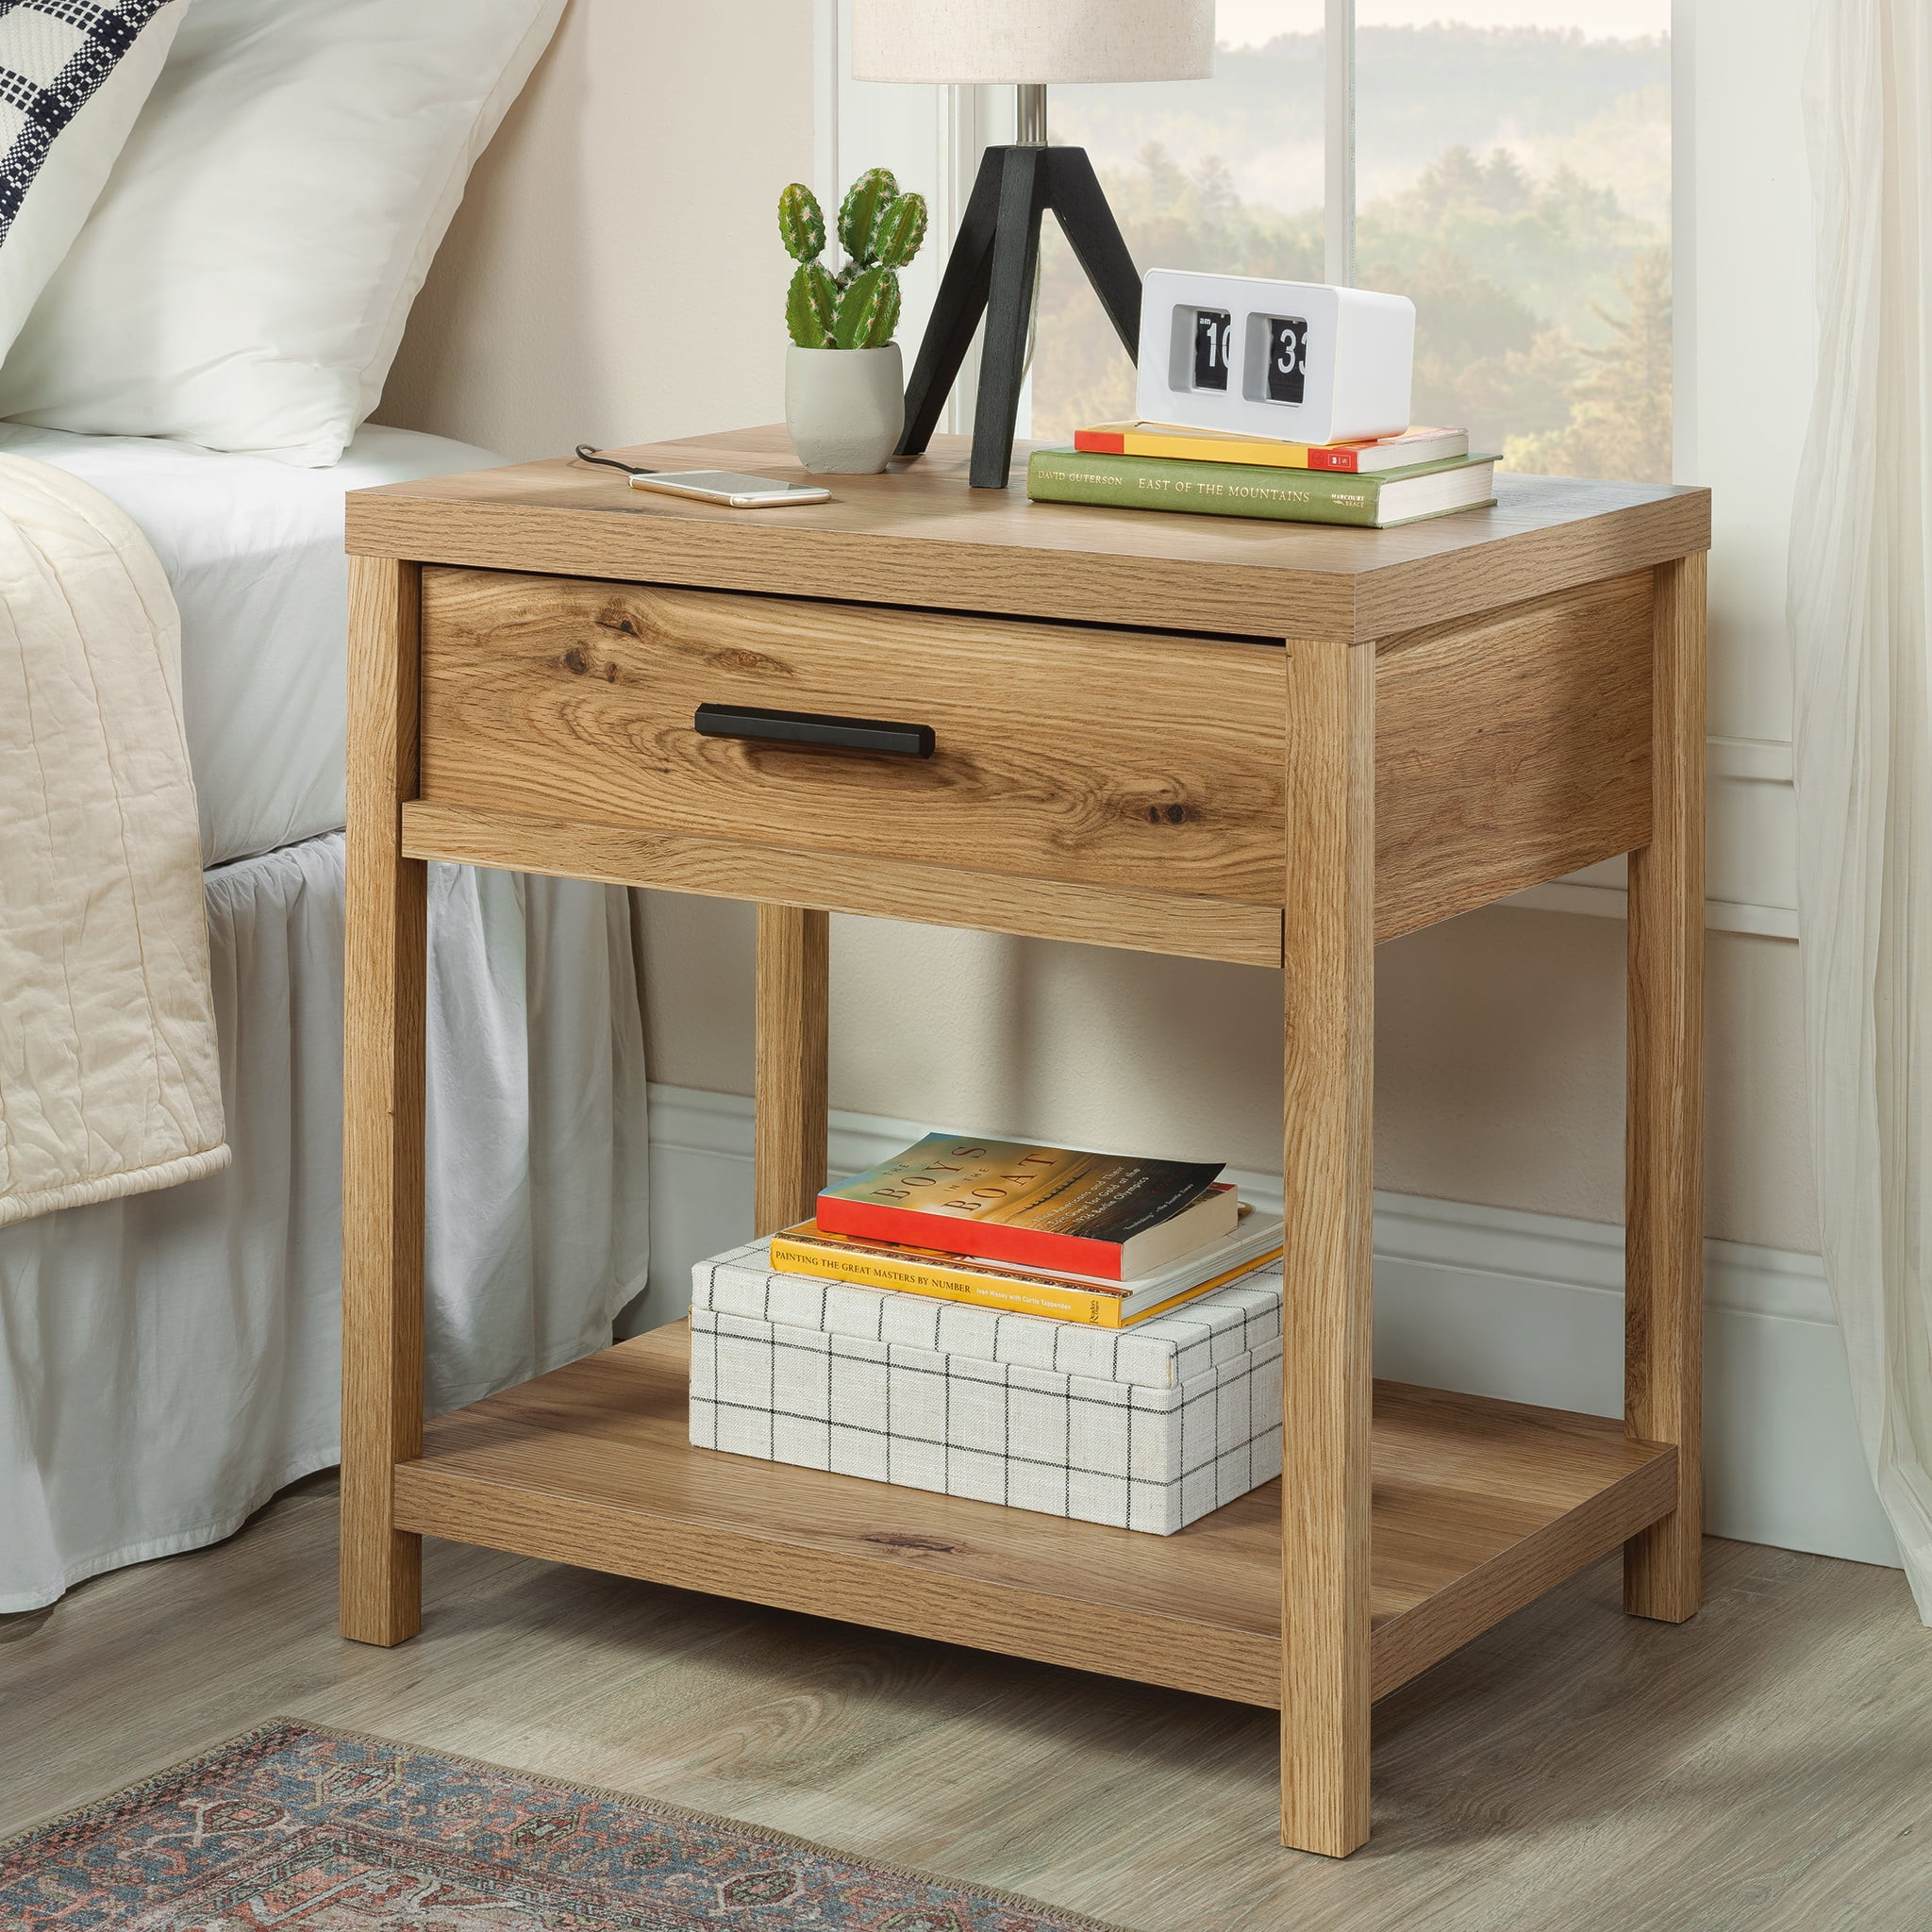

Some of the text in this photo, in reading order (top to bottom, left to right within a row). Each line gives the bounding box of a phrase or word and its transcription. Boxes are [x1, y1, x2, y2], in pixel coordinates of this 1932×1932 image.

[1199, 317, 1211, 325] am
[1038, 470, 1310, 503] DAVID GUTERSON EAST OF THE MOUNTAINS
[869, 1146, 988, 1201] BOYS
[882, 1163, 910, 1176] THE
[940, 1153, 1058, 1212] BOAT
[942, 1167, 990, 1193] IN THE
[1091, 1179, 1107, 1191] and
[1098, 1183, 1121, 1197] Gold
[775, 1251, 819, 1267] PAINTING
[820, 1258, 840, 1270] THE
[841, 1262, 872, 1275] GREAT
[873, 1268, 916, 1284] MASTERS
[917, 1276, 930, 1286] BY
[931, 1278, 972, 1294] NUMBER
[1008, 1293, 1022, 1302] with
